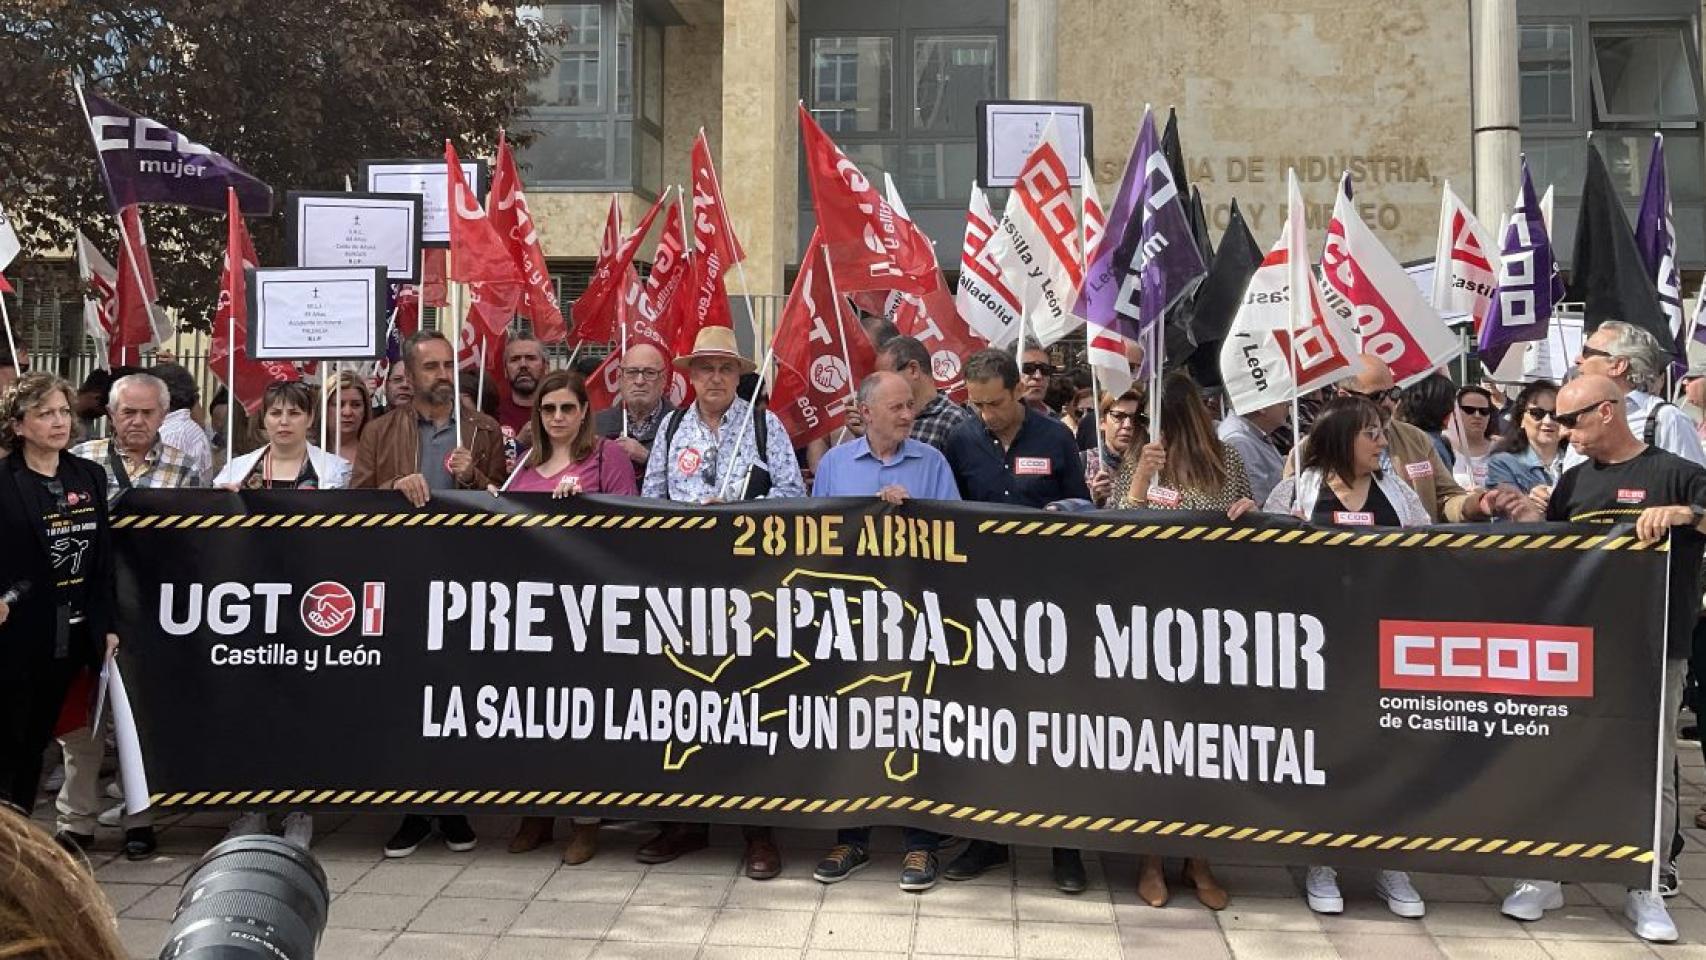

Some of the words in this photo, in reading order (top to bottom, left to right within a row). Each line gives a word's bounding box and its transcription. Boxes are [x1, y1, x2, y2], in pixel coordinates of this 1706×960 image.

[140, 158, 207, 178] mujer
[1227, 155, 1265, 183] DE
[1242, 344, 1269, 392] León
[797, 396, 820, 428] eón
[733, 515, 787, 556] 28
[795, 515, 844, 557] DE
[856, 515, 968, 563] ABRIL
[159, 582, 292, 635] UGT
[427, 580, 753, 656] PREVENIR
[776, 587, 950, 665] PARA
[976, 598, 1067, 675] NO
[1095, 604, 1326, 691] MORIR
[211, 643, 298, 666] Castilla
[304, 649, 318, 670] y
[325, 644, 381, 666] León
[1394, 635, 1579, 682] CCOO
[1380, 696, 1488, 713] comisiones
[1494, 699, 1568, 717] obreras
[1380, 713, 1402, 729] de
[1408, 714, 1478, 733] Castilla
[1484, 720, 1497, 738] y
[1502, 719, 1550, 736] León
[422, 685, 467, 737] LA
[475, 685, 595, 739] SALUD
[605, 687, 779, 756] LABORAL,
[788, 694, 838, 749] UN
[849, 696, 1017, 764] DERECHO
[1028, 711, 1326, 785] FUNDAMENTAL
